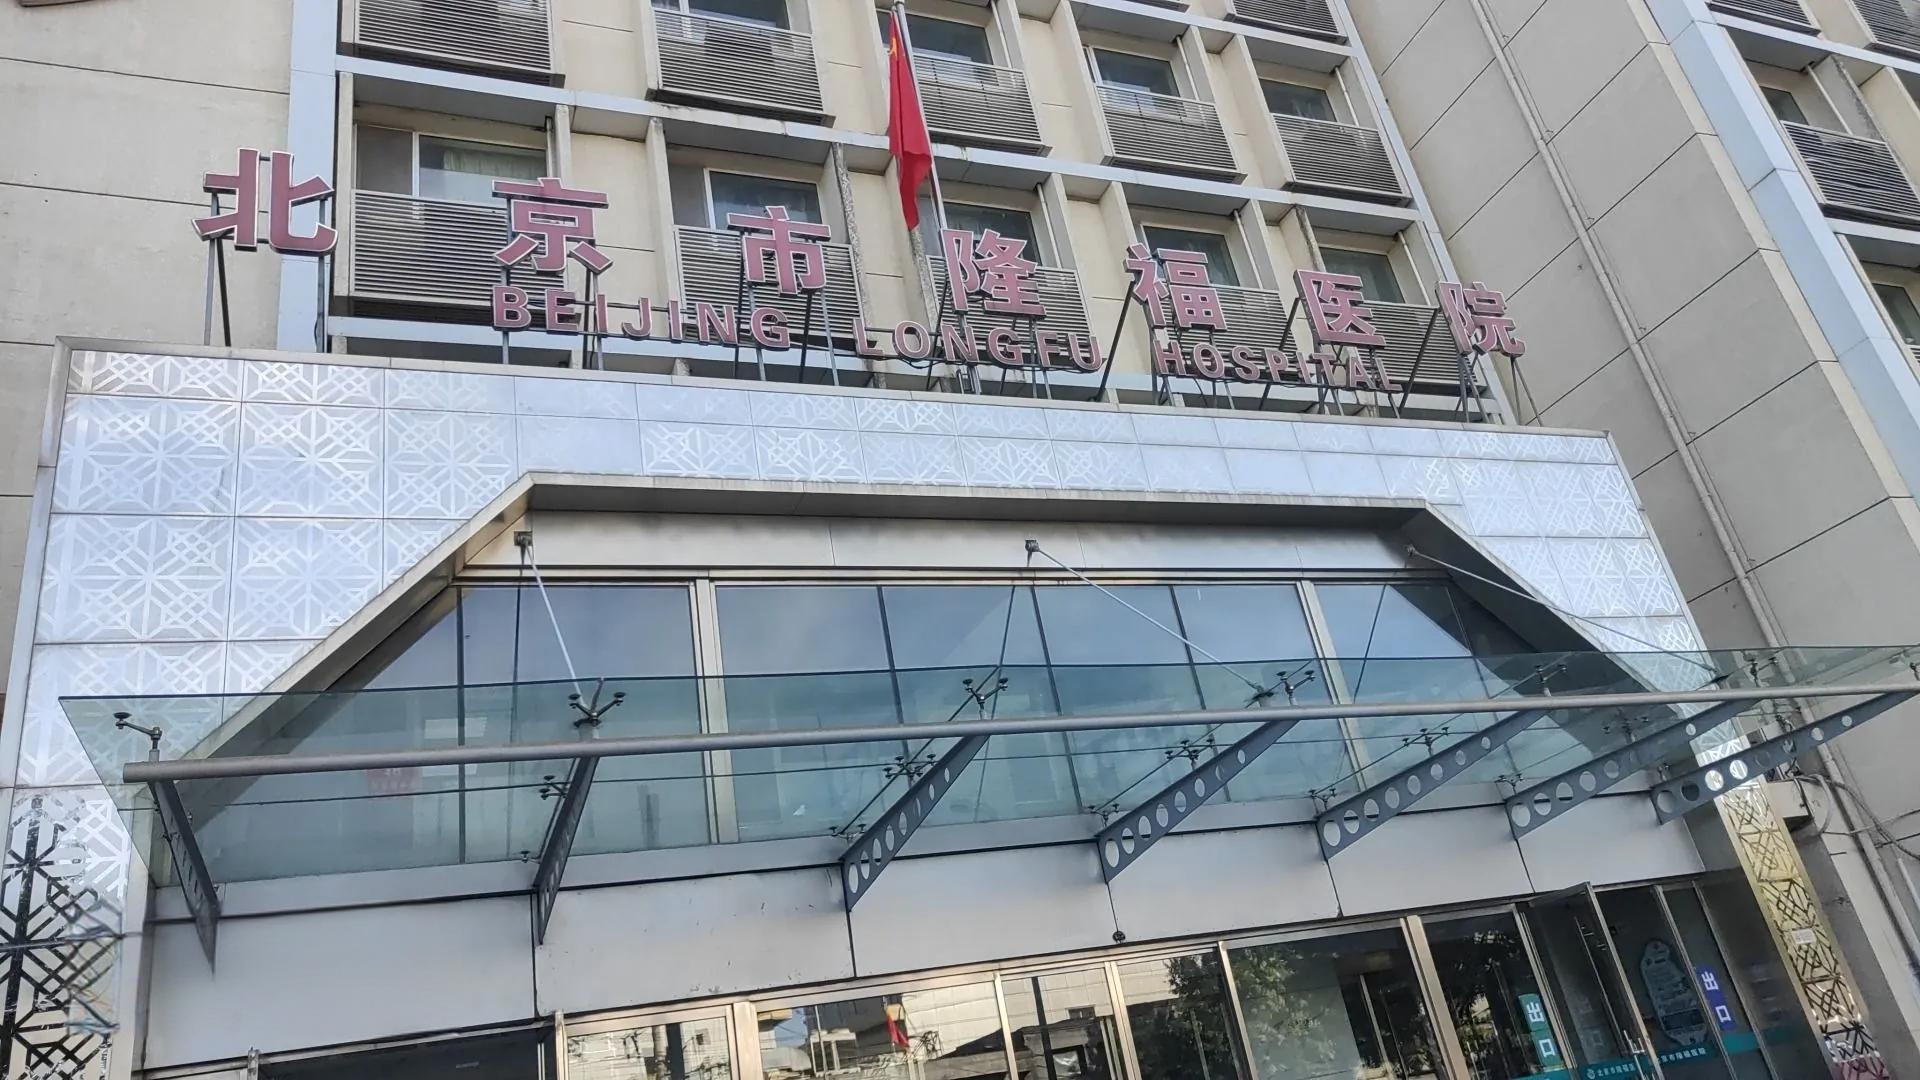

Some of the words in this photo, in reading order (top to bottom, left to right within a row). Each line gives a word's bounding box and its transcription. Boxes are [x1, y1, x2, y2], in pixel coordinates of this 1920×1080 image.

[192, 148, 1525, 357] 北京市隆福医院
[493, 284, 790, 350] BEIJING
[852, 318, 1103, 371] LONGFU
[1152, 339, 1402, 393] HOSPITAL
[1526, 1002, 1555, 1057] 出口
[1701, 971, 1732, 1022] 出口
